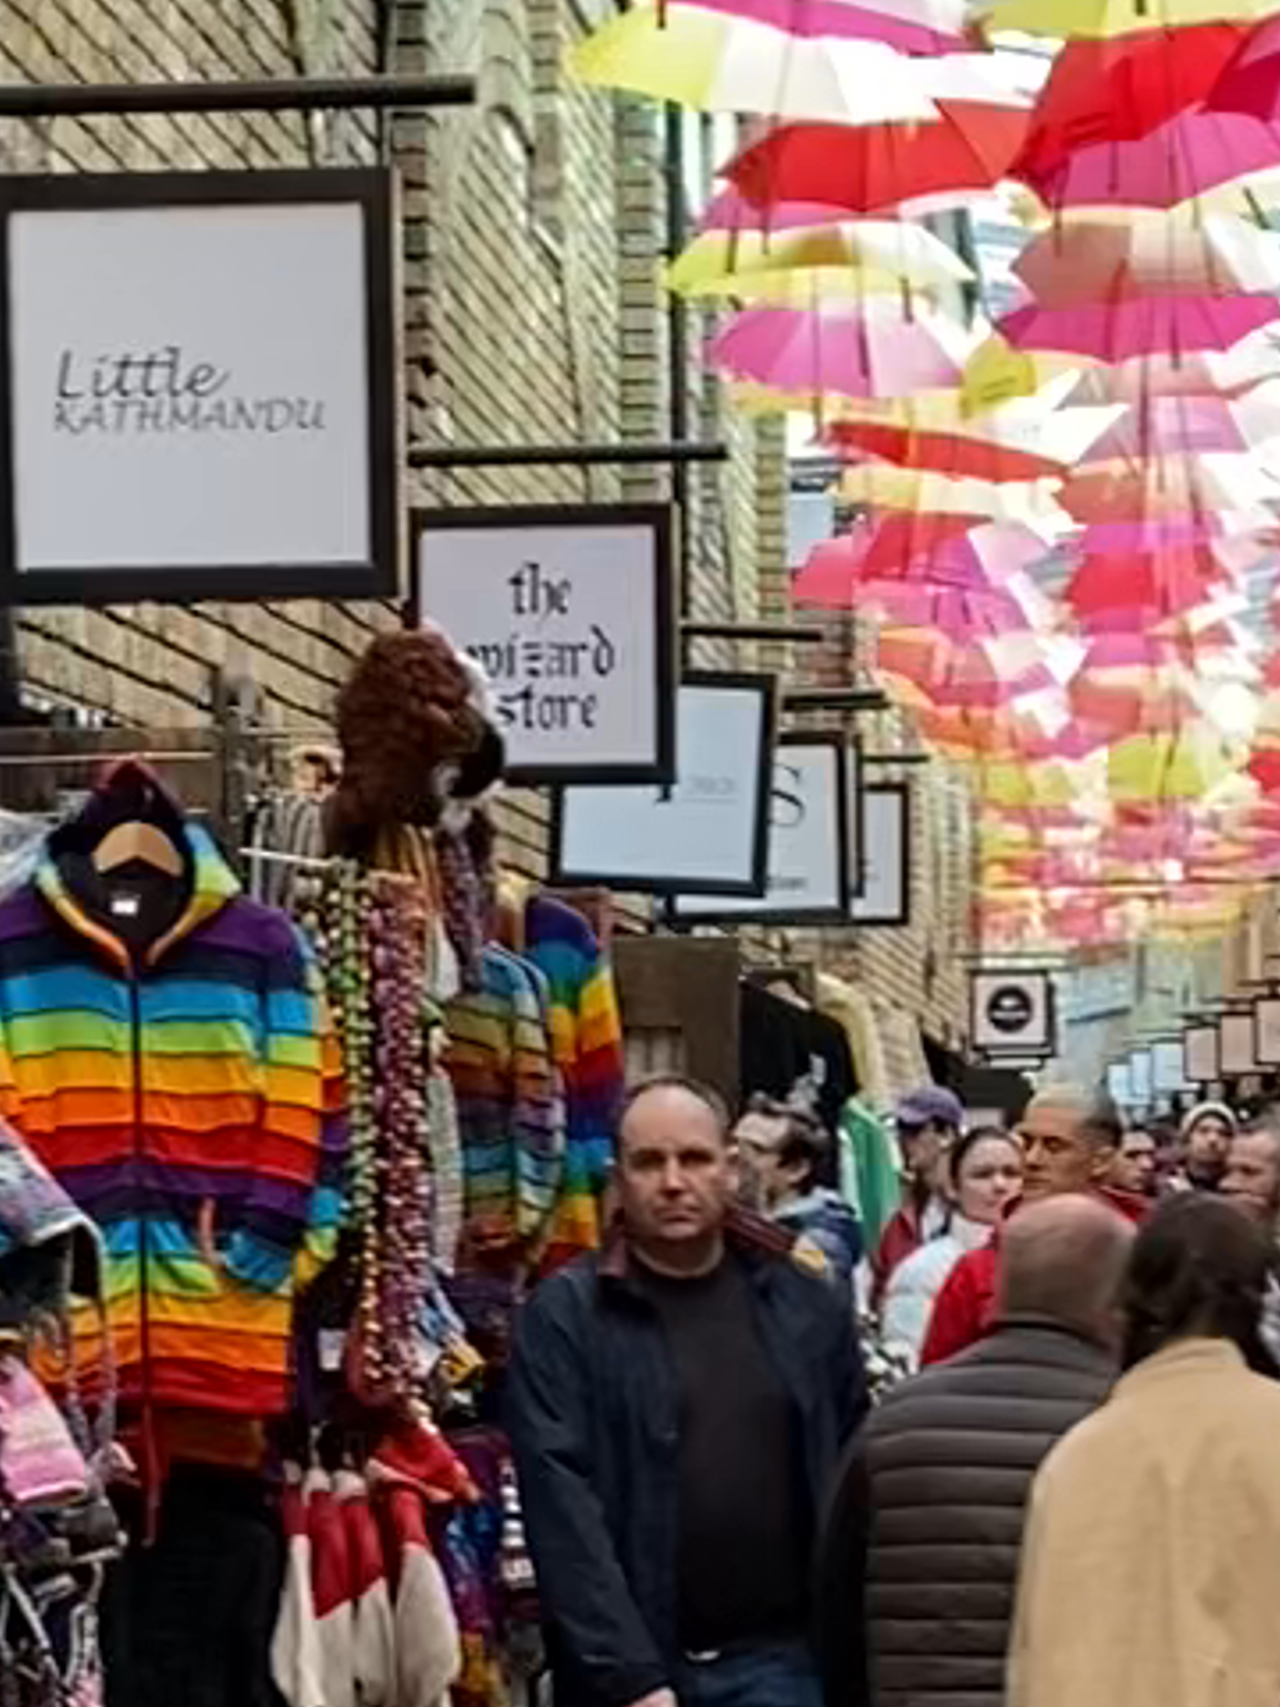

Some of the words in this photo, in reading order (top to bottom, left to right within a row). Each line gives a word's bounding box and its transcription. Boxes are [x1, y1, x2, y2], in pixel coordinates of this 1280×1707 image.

[56, 346, 232, 399] Little
[55, 395, 326, 436] KATHMANDU
[508, 559, 573, 619] the
[495, 682, 598, 730] store
